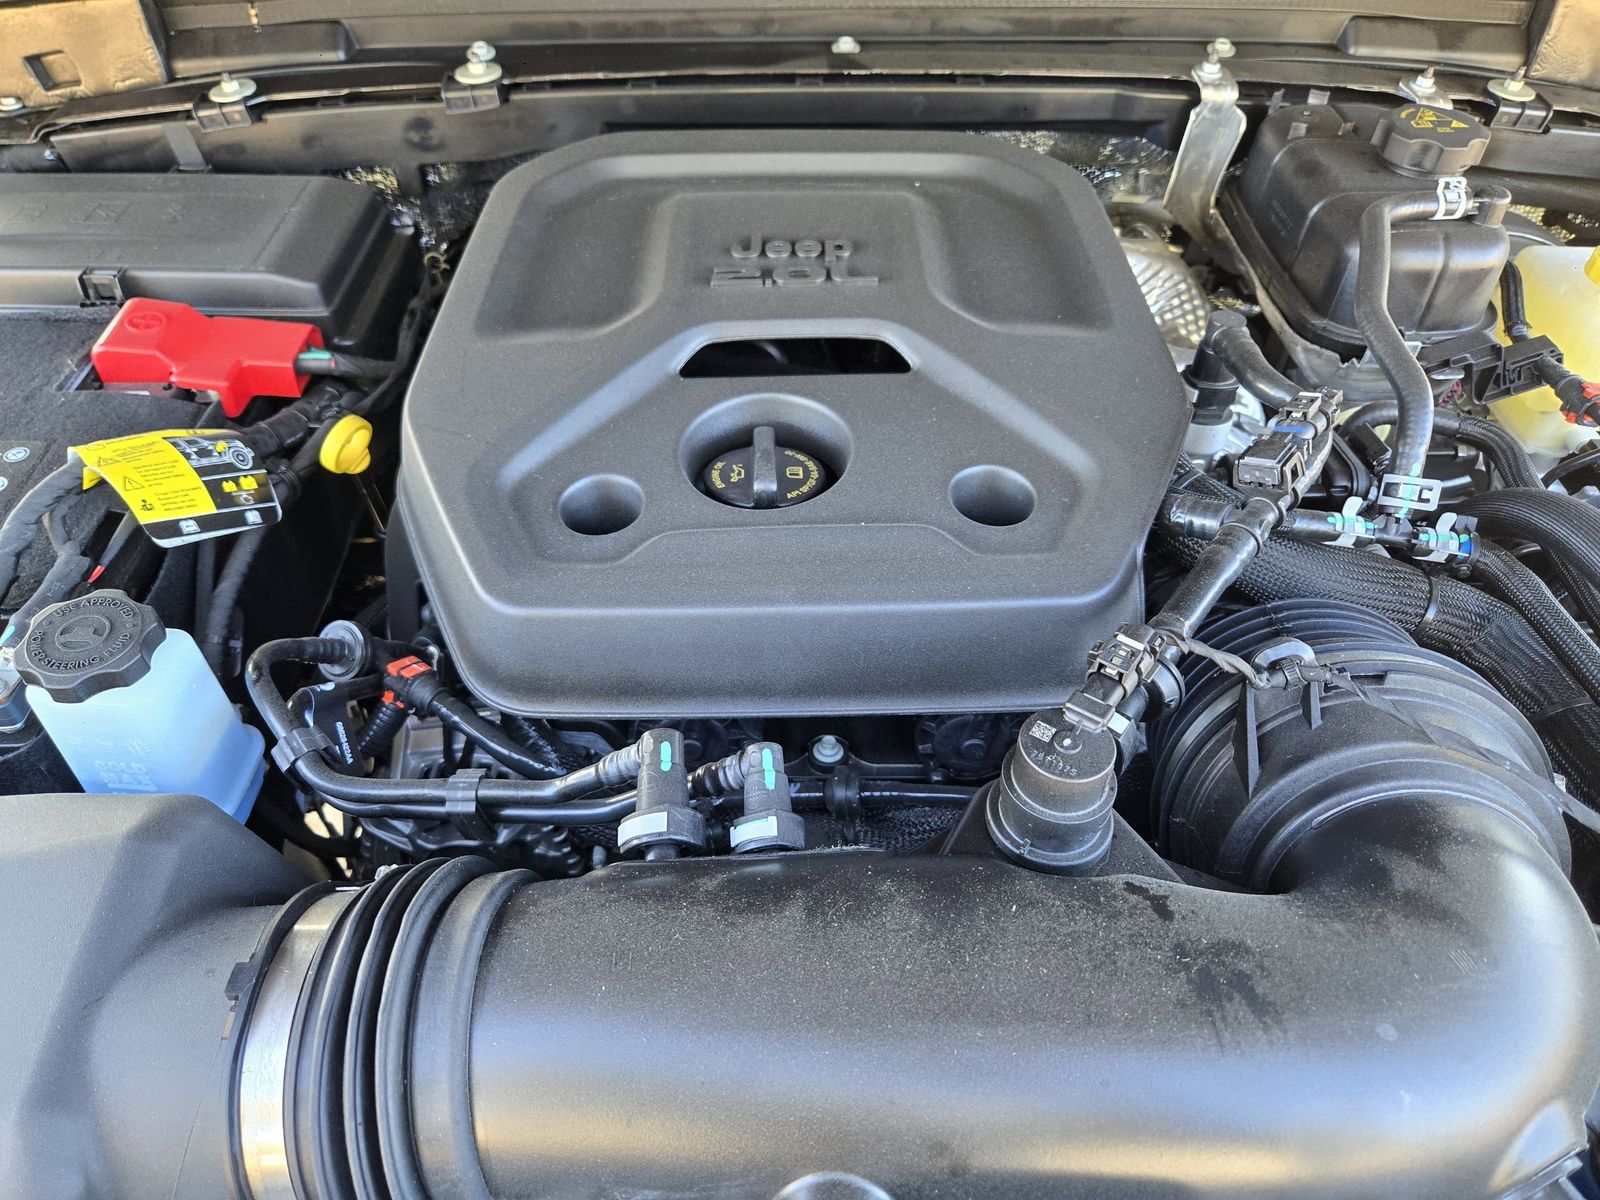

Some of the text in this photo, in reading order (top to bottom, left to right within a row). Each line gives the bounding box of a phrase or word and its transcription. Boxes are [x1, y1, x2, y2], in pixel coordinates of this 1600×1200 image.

[730, 233, 853, 264] Jeep
[710, 262, 880, 288] 2.0L
[711, 461, 726, 489] ENGINE OIL
[787, 490, 802, 499] API
[53, 603, 77, 617] USE
[80, 597, 134, 619] APPROVED
[30, 630, 131, 670] POWER STEERING FLUID
